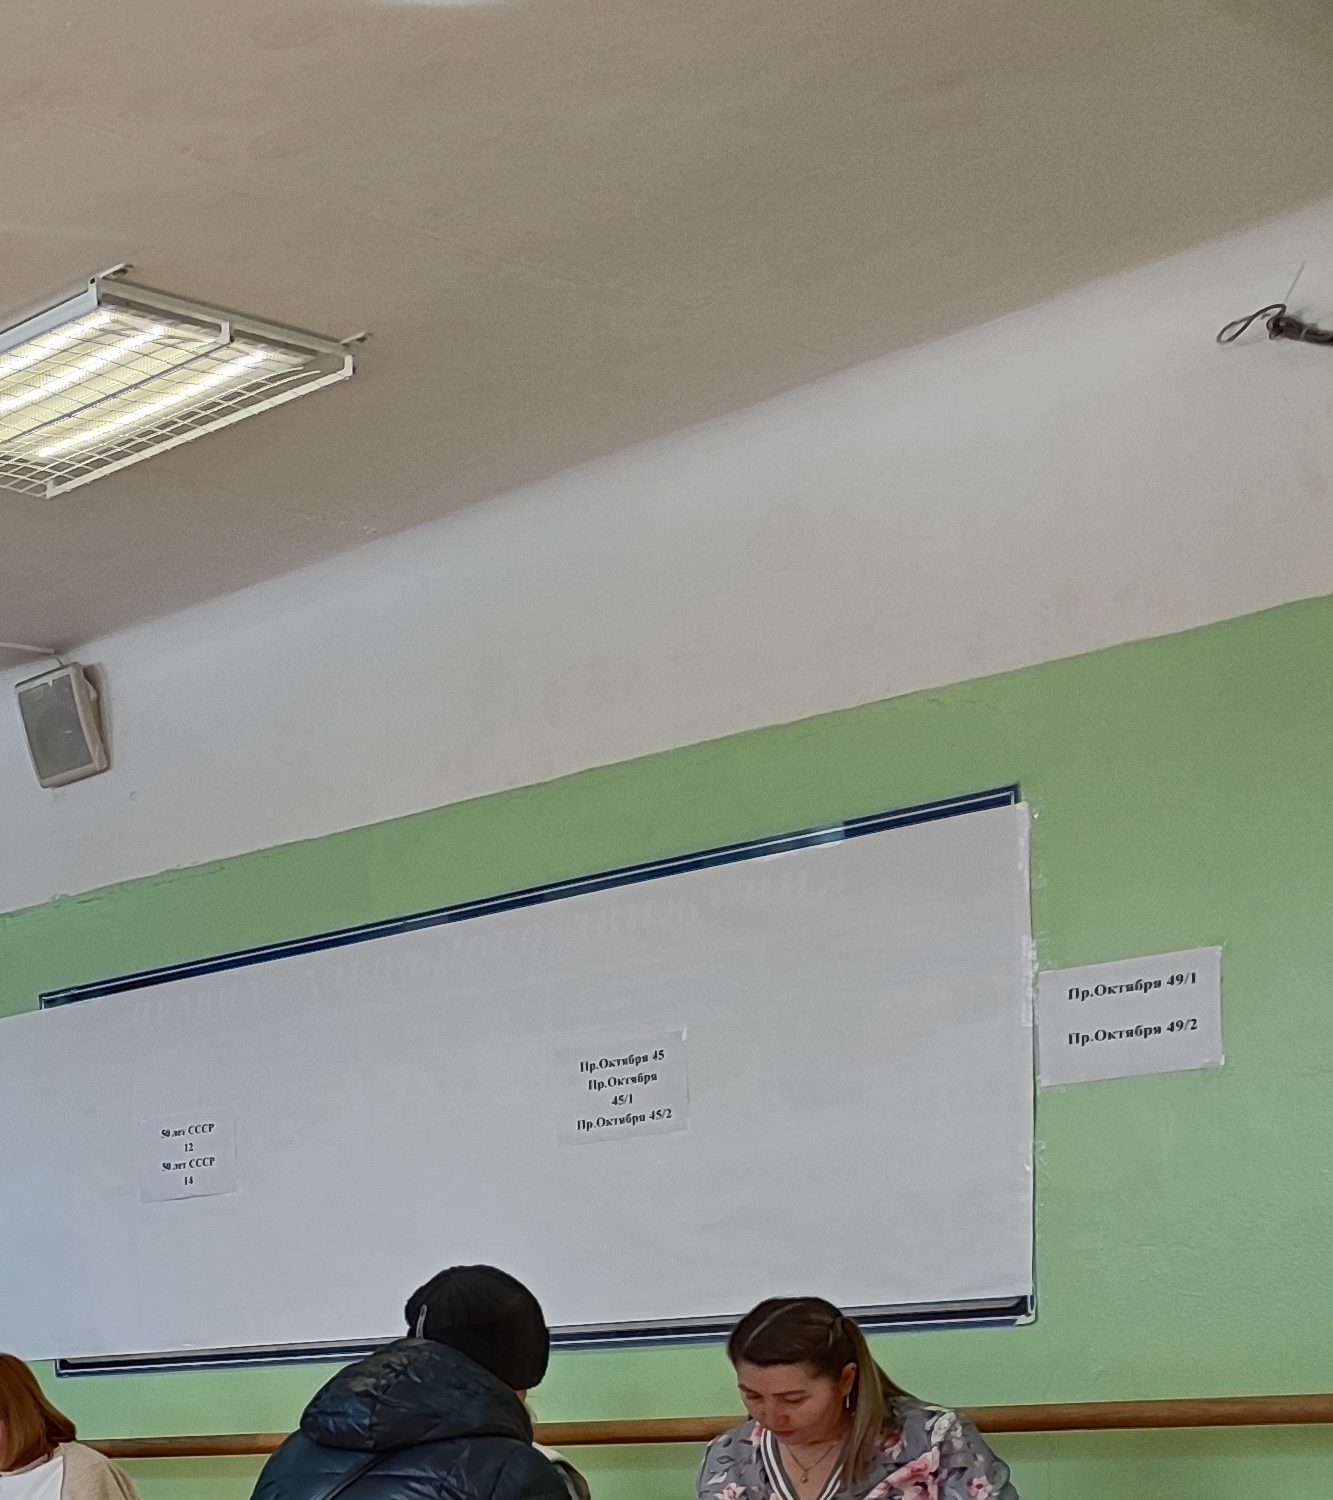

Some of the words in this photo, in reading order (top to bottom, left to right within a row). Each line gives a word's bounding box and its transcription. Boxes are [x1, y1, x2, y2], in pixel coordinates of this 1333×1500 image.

[1068, 978, 1162, 1001] Пр.Октября
[1166, 972, 1197, 986] 49/1
[1068, 1025, 1162, 1047] Пр.Октября
[1166, 1018, 1198, 1032] 49/2
[579, 1054, 649, 1074] Пр.Октября
[652, 1049, 665, 1061] 45
[588, 1072, 658, 1092] Пр.Октября
[611, 1093, 633, 1106] 45/1
[187, 1123, 215, 1135] СССР
[576, 1113, 646, 1132] Пр.Октября
[648, 1108, 673, 1121] 45/2
[184, 1142, 194, 1153] 12
[188, 1156, 216, 1169] СССР
